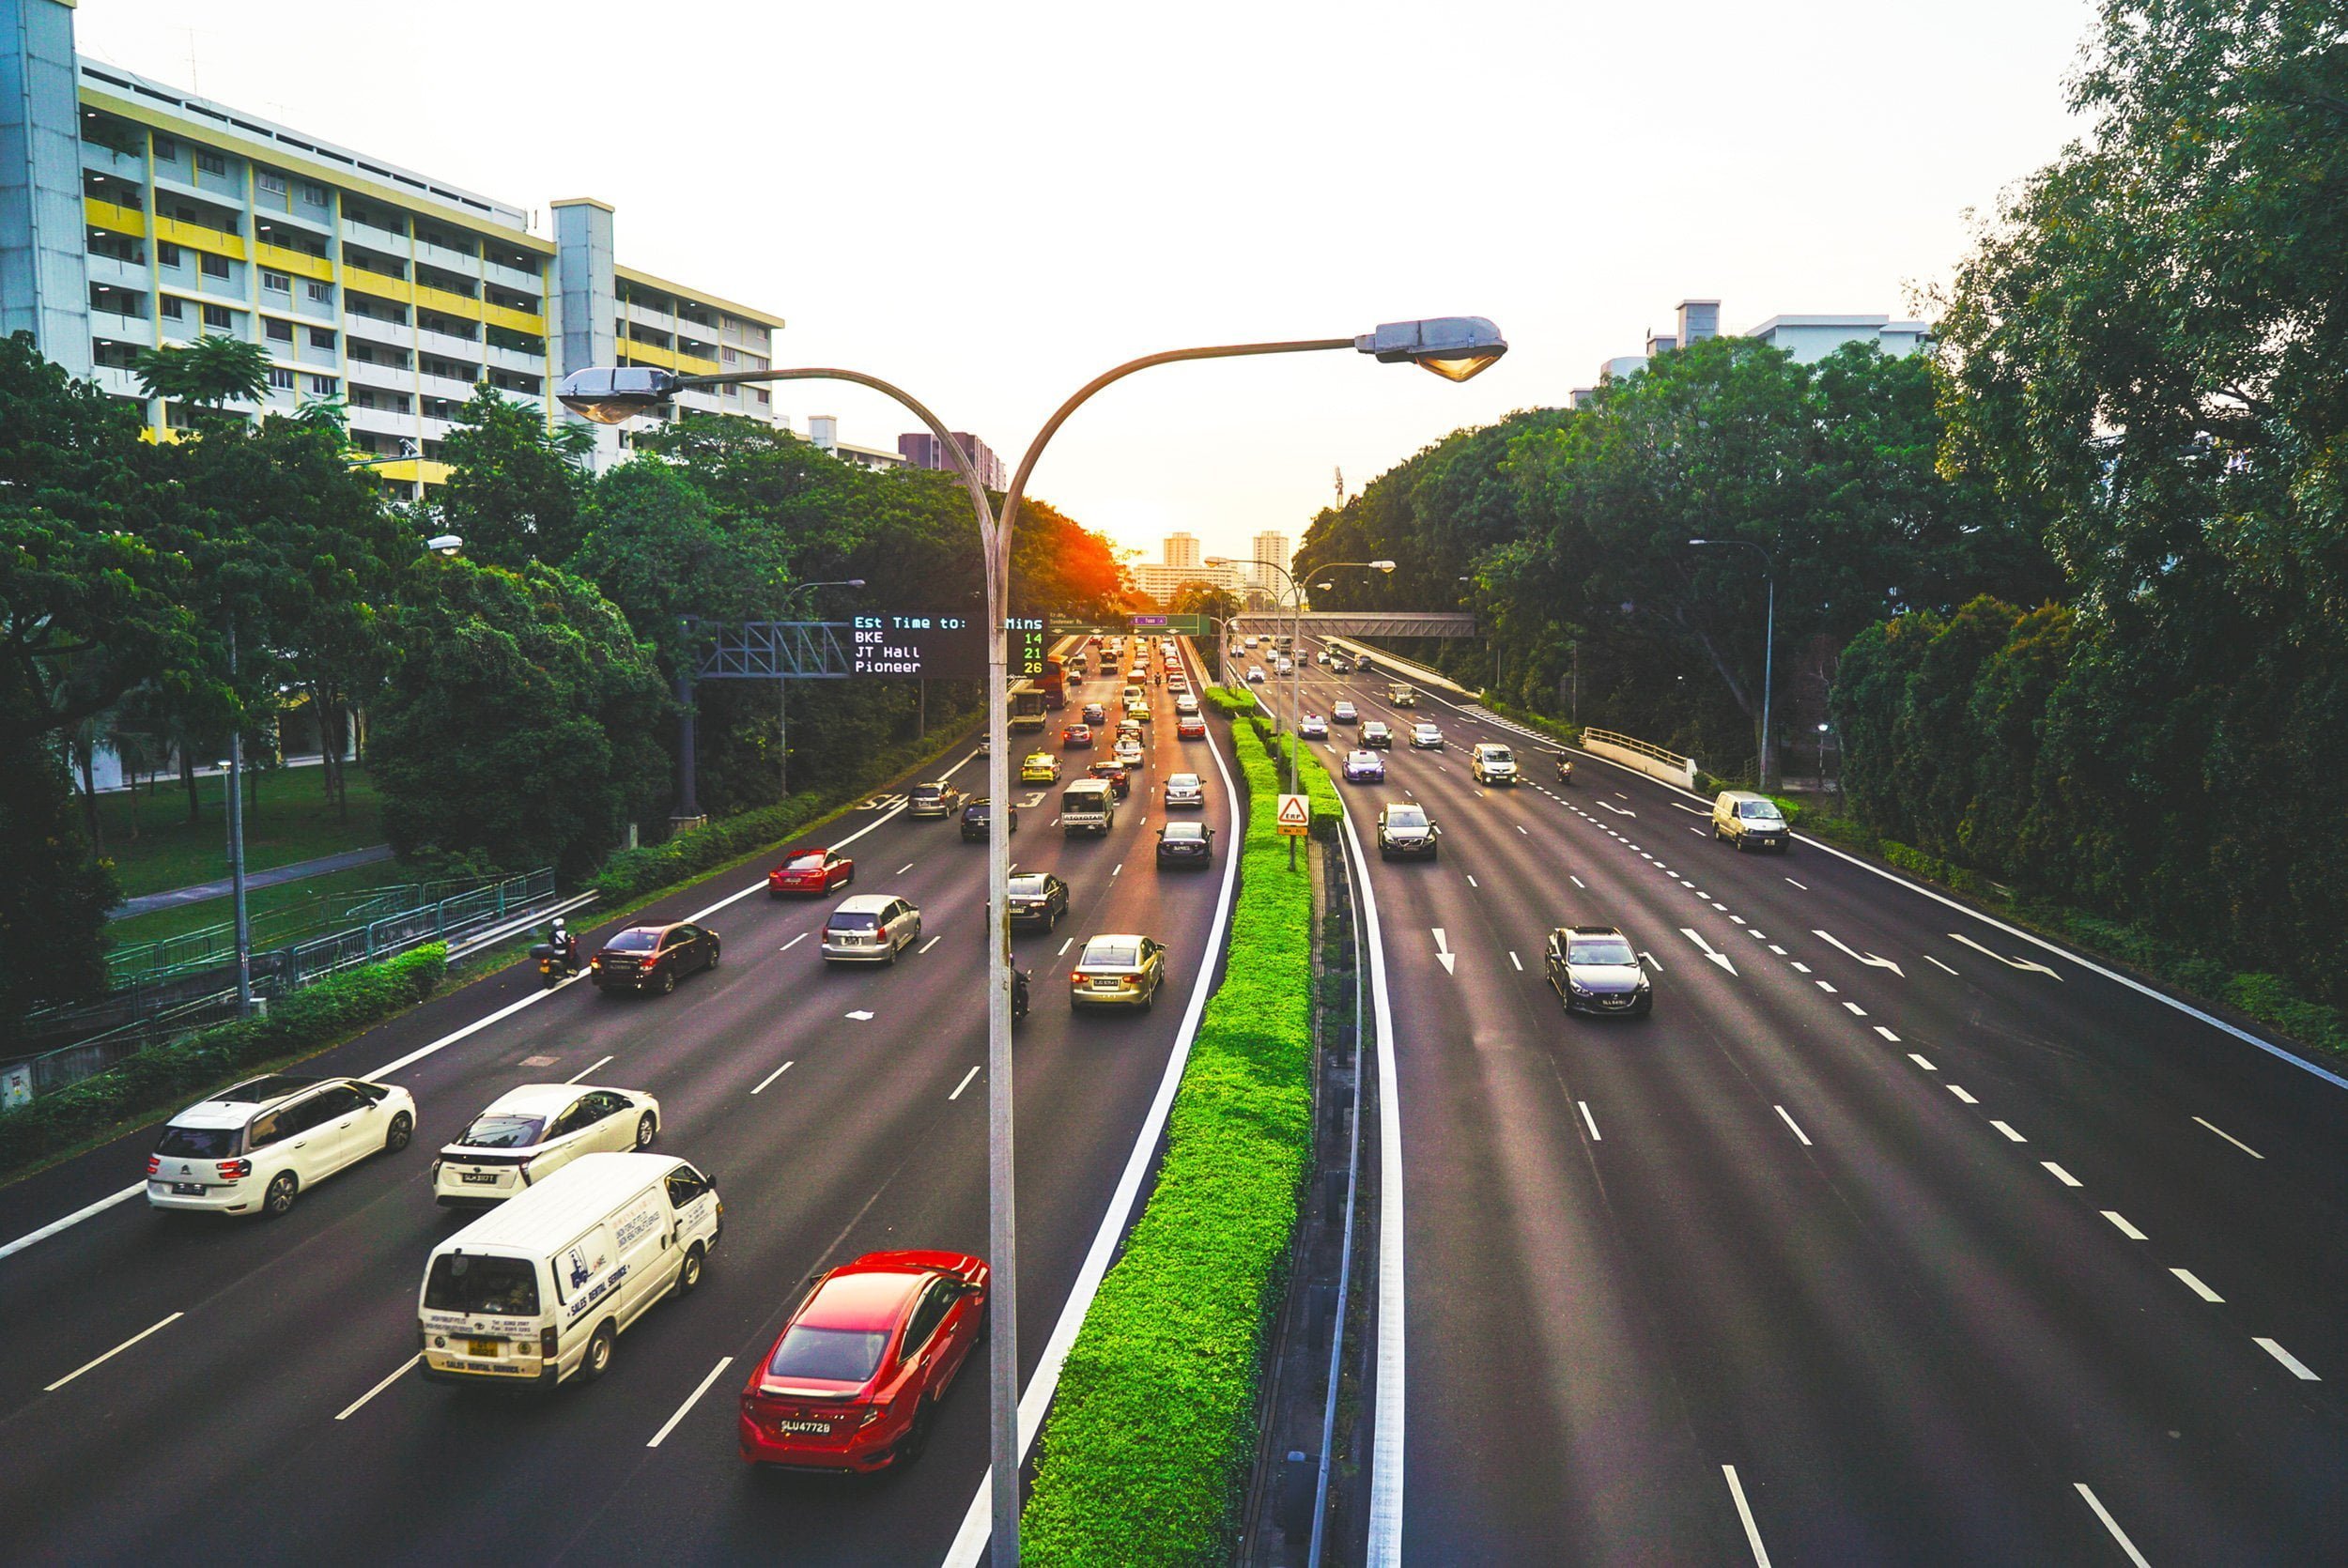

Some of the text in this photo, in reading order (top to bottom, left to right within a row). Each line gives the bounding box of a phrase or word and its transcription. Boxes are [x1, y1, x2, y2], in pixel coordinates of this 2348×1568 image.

[854, 616, 1043, 630] Est Time to: Mins
[855, 631, 1043, 645] BKE 14
[855, 646, 1042, 659] JT Hall 21
[855, 660, 1043, 674] Pioneer 26
[571, 1264, 627, 1316] SALES RENTAL SERVICE
[780, 1420, 830, 1434] SLU4772B
